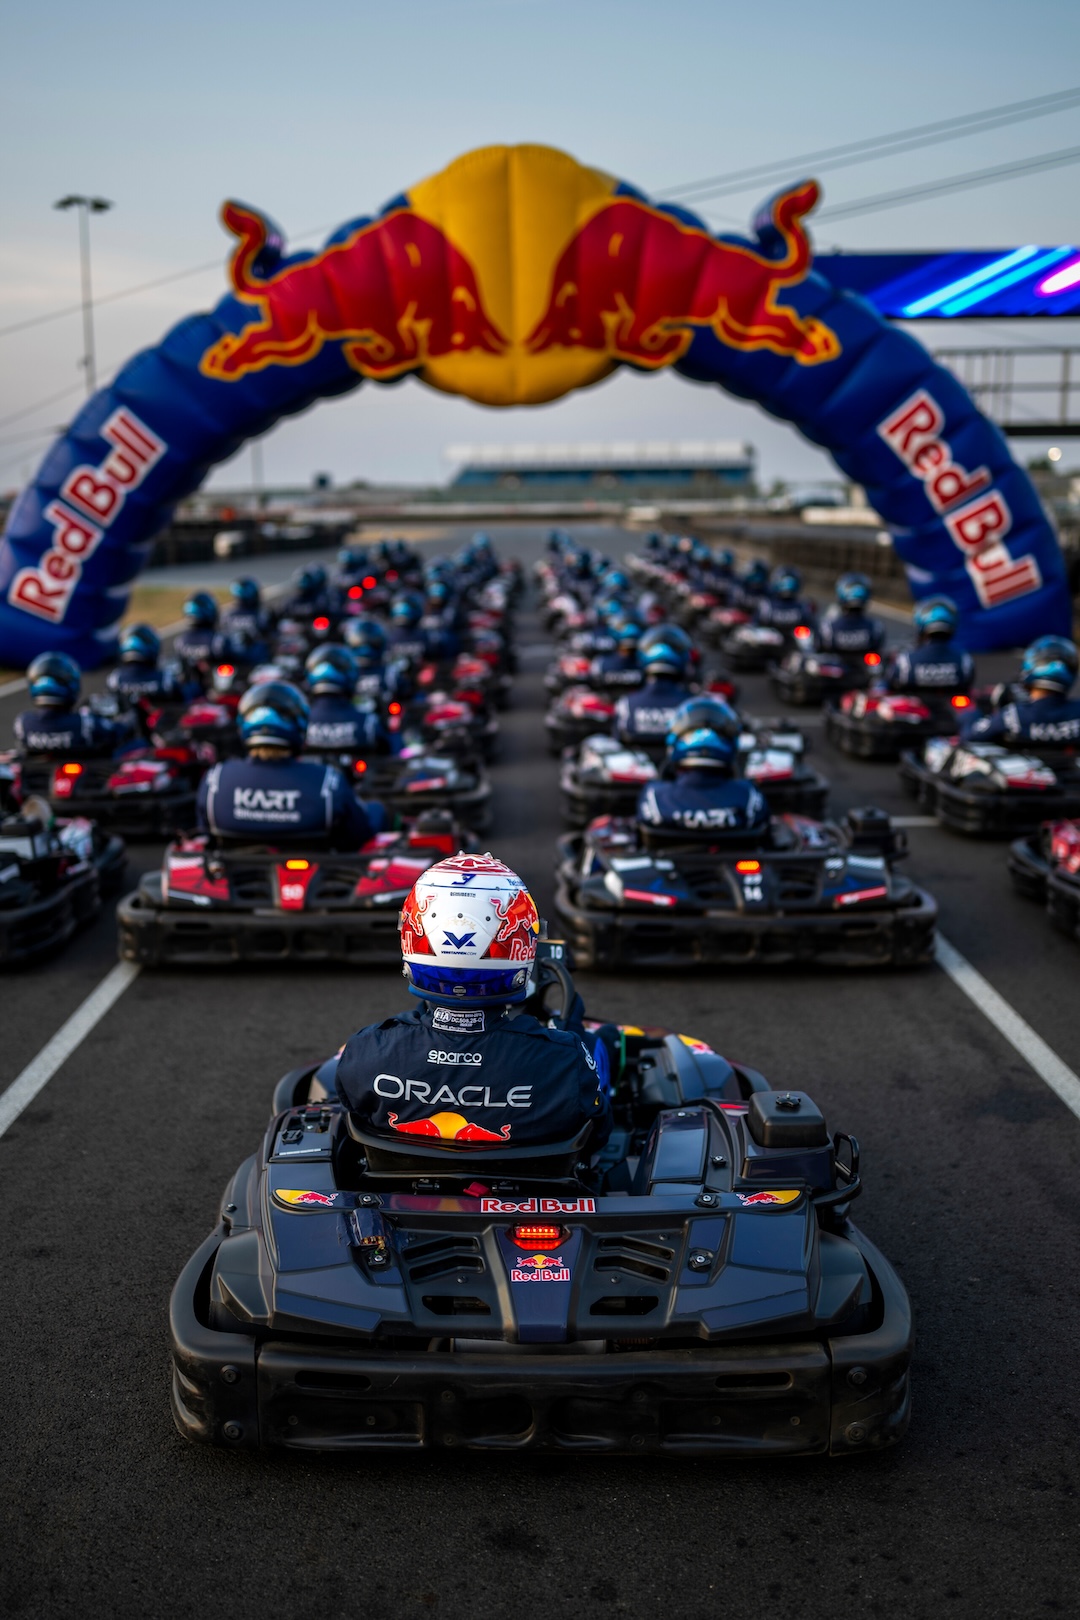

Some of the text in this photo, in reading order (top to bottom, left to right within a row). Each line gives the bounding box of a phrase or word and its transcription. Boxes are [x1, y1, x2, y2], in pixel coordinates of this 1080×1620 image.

[877, 389, 1041, 608] Red Bull
[9, 405, 167, 624] Red Bull
[234, 788, 301, 809] KART
[550, 946, 563, 960] 10
[435, 1010, 450, 1021] FIA
[427, 1049, 482, 1066] sparco
[373, 1074, 533, 1107] ORACLE
[481, 1198, 596, 1214] Red Bull
[511, 1268, 571, 1281] Red Bull
